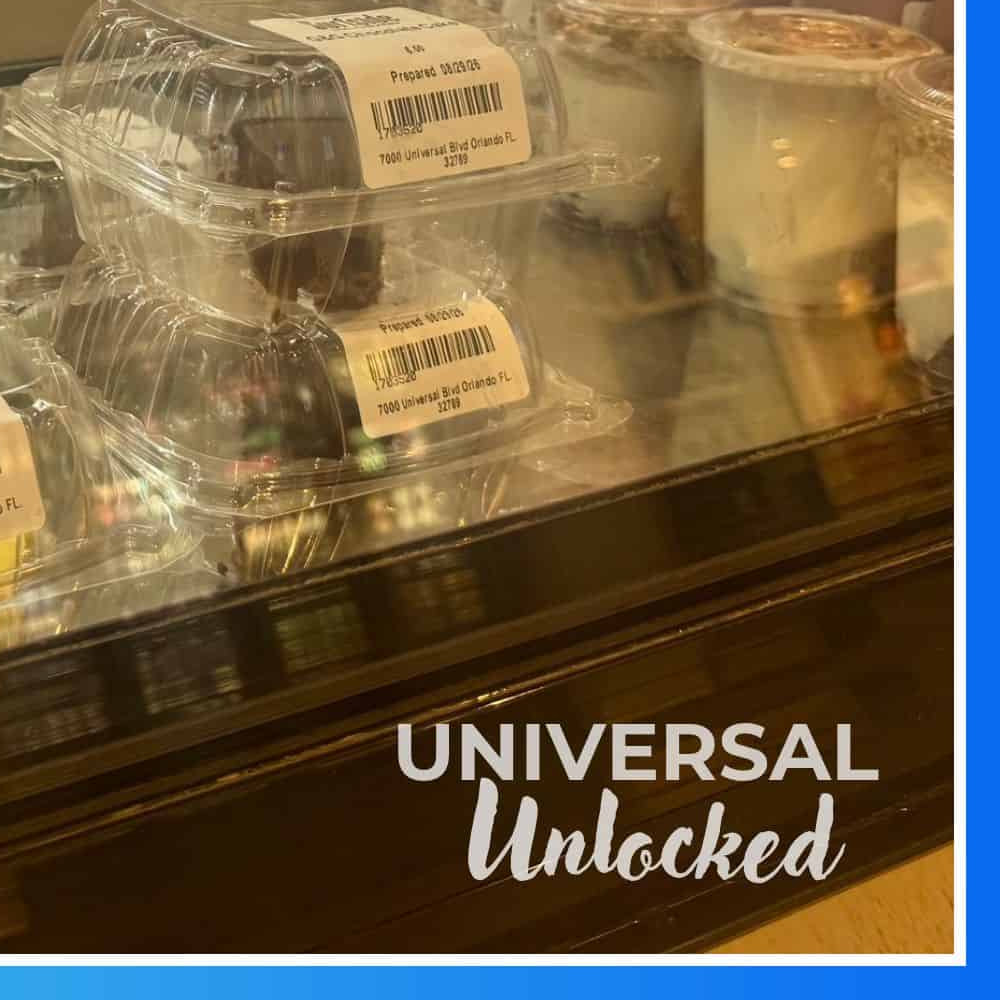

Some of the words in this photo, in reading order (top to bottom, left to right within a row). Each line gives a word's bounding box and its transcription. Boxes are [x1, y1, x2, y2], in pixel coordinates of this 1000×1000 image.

[390, 67, 437, 84] Prepared
[440, 58, 481, 76] 08/29/26
[379, 152, 403, 167] 7000
[404, 143, 448, 162] Universal
[449, 140, 469, 155] Blvd
[471, 135, 505, 151] Orlando
[443, 154, 469, 168] 32789
[379, 318, 424, 335] Prepared
[377, 400, 401, 416] 7000
[401, 390, 440, 411] Universal
[441, 386, 461, 399] Blvd
[462, 375, 497, 392] Orlando
[437, 397, 462, 414] 32789
